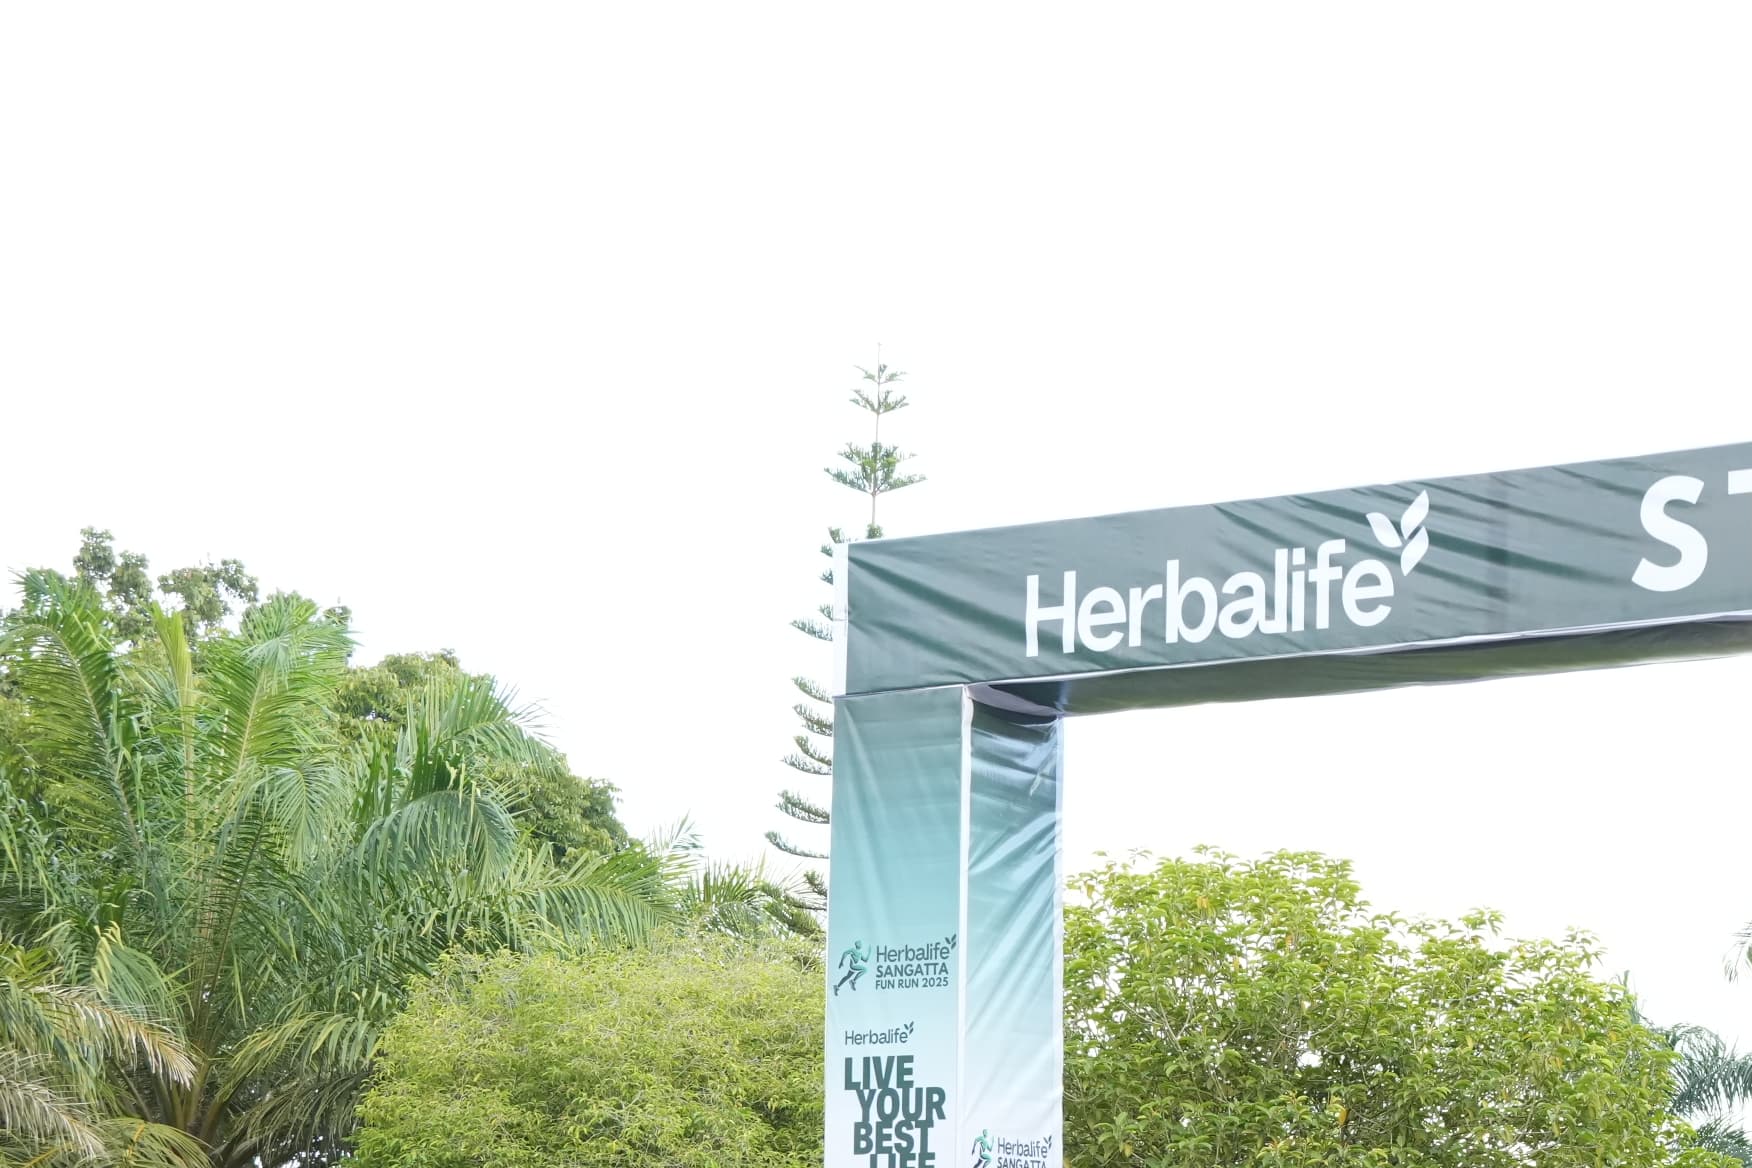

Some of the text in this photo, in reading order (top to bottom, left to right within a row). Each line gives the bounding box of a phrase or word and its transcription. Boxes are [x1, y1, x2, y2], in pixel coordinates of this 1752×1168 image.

[1025, 537, 1394, 658] Herbalife
[876, 942, 950, 963] Herbalife
[876, 962, 949, 979] SANGATTA
[875, 976, 949, 990] FUN RUN 2025
[845, 1029, 909, 1046] Herbalife
[844, 1055, 914, 1090] LIVE
[855, 1086, 946, 1124] YOUR
[854, 1120, 935, 1155] BEST
[997, 1137, 1048, 1159] Herbalife
